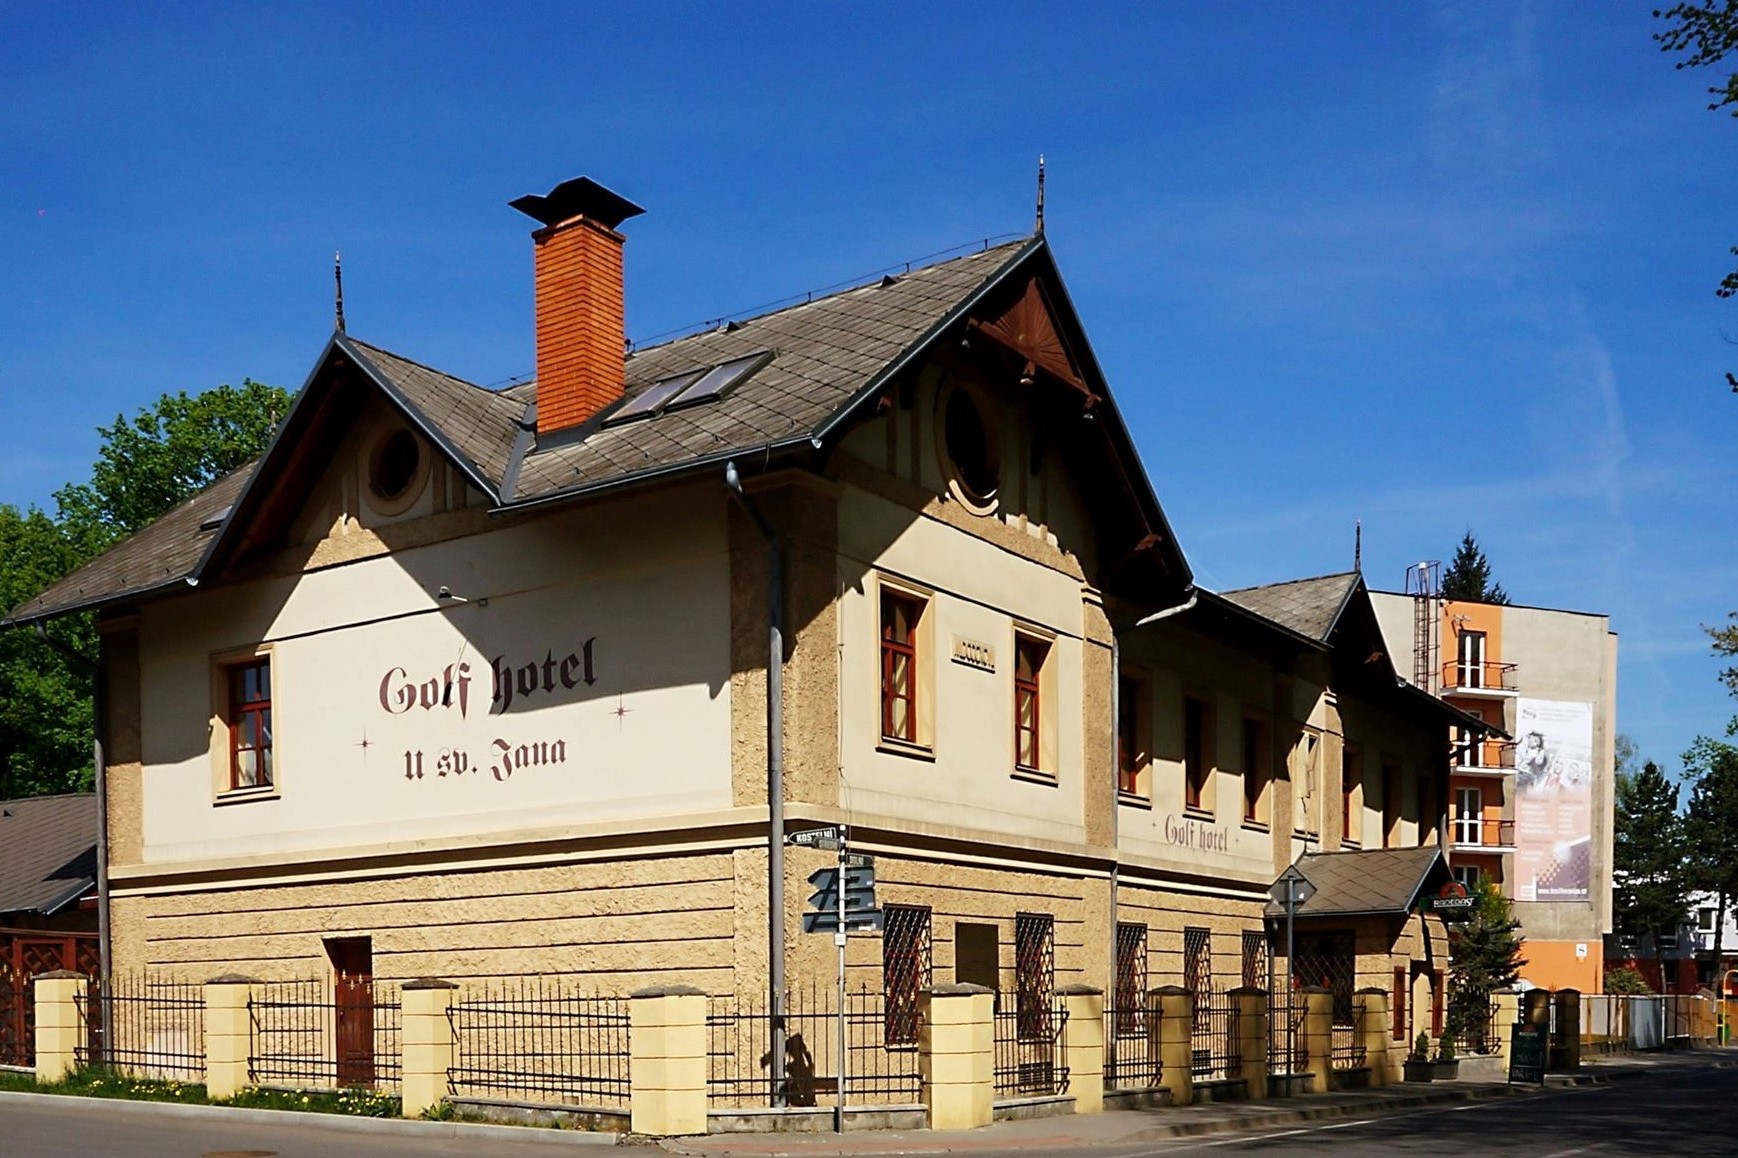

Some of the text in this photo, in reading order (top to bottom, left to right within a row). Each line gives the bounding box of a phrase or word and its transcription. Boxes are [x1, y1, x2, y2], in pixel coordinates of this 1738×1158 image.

[379, 662, 472, 721] Golf
[490, 738, 567, 782] Jana
[1165, 814, 1195, 853] Golf
